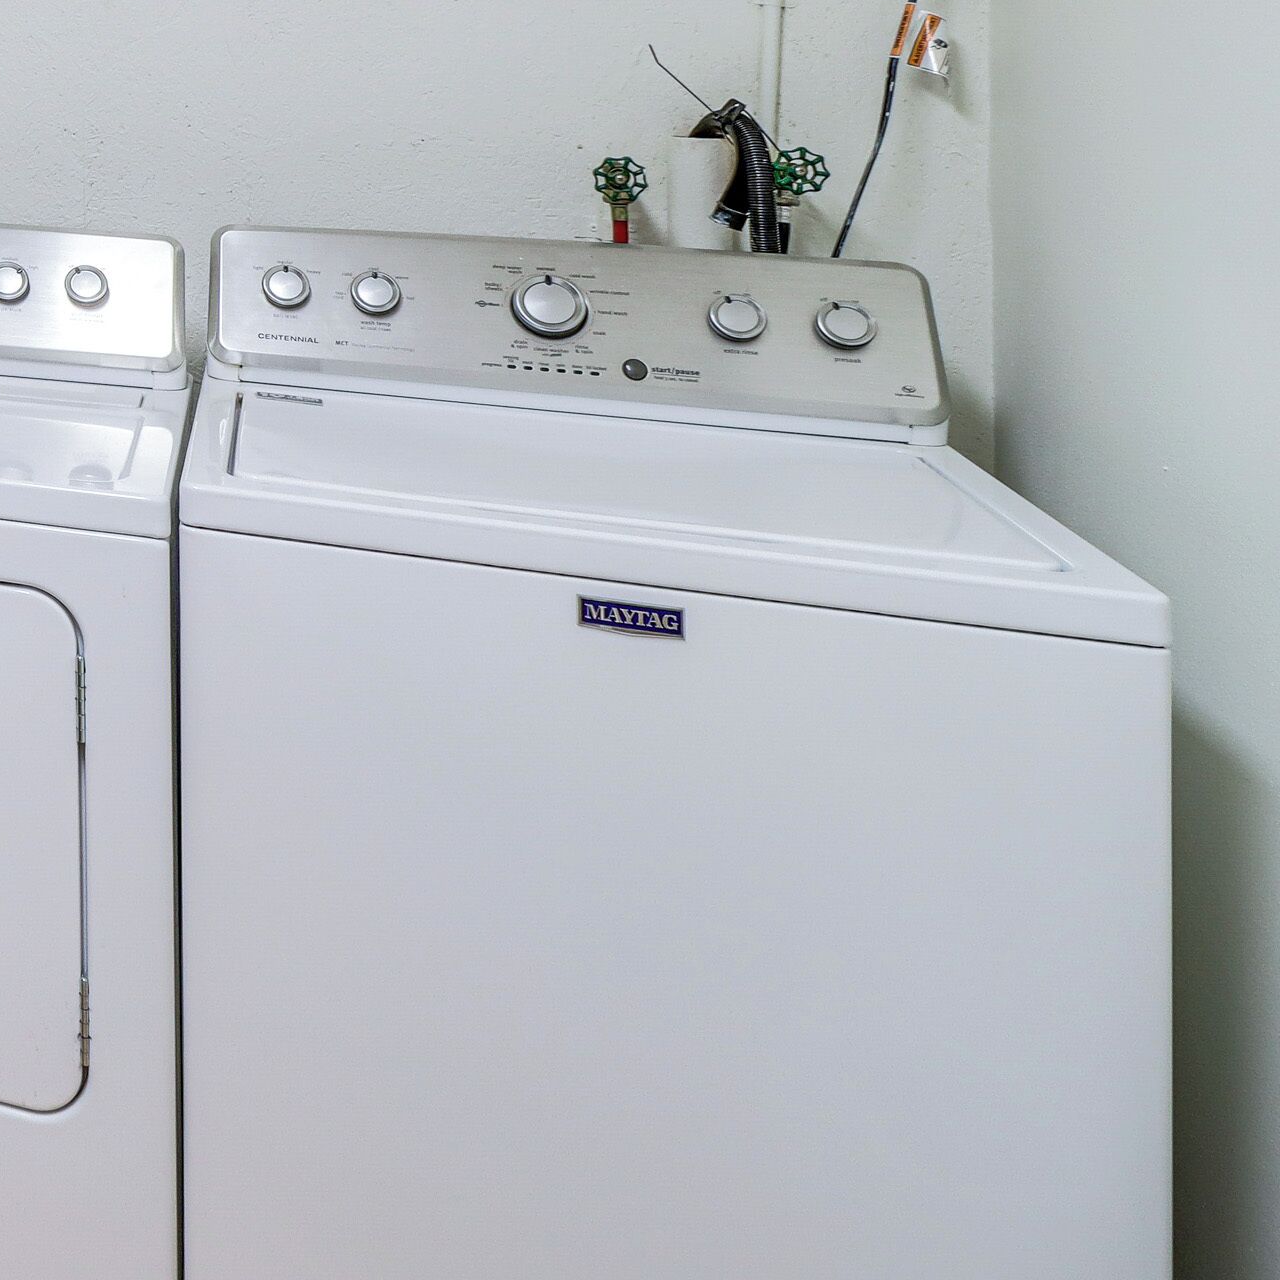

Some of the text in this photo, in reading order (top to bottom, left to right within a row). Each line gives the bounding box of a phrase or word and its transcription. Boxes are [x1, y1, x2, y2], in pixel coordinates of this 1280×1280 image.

[257, 332, 319, 344] CENTENNIAL
[651, 367, 700, 376] start/pause
[583, 603, 679, 631] MAYTAG
